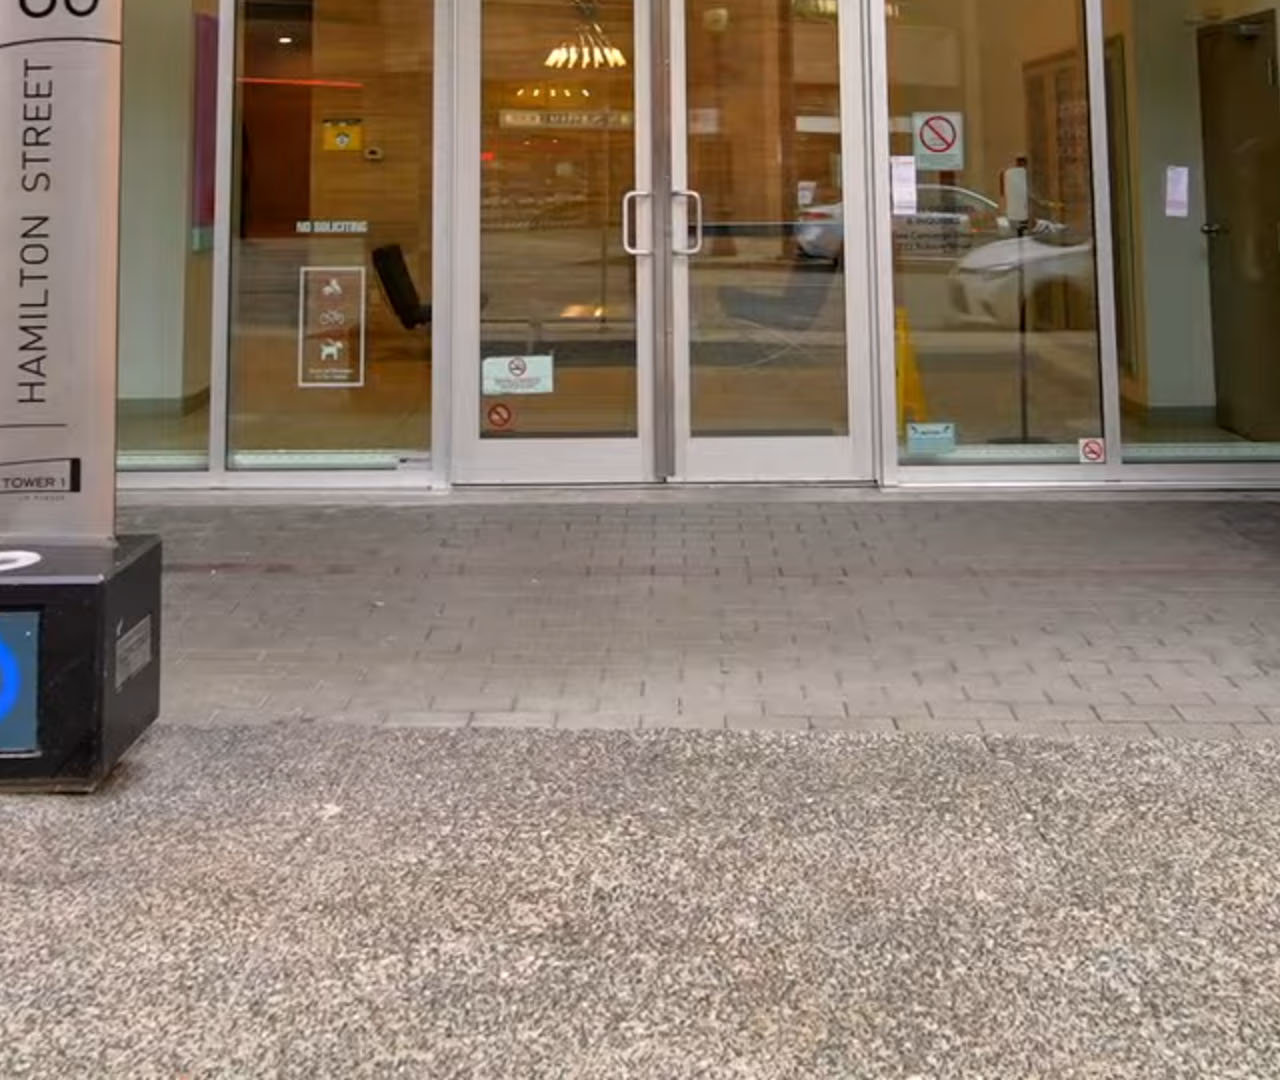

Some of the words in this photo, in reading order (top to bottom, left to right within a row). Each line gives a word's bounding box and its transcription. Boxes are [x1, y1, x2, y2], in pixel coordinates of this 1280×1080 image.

[22, 58, 54, 192] STREET
[17, 215, 50, 404] HAMILTON
[2, 477, 56, 489] TOWER
